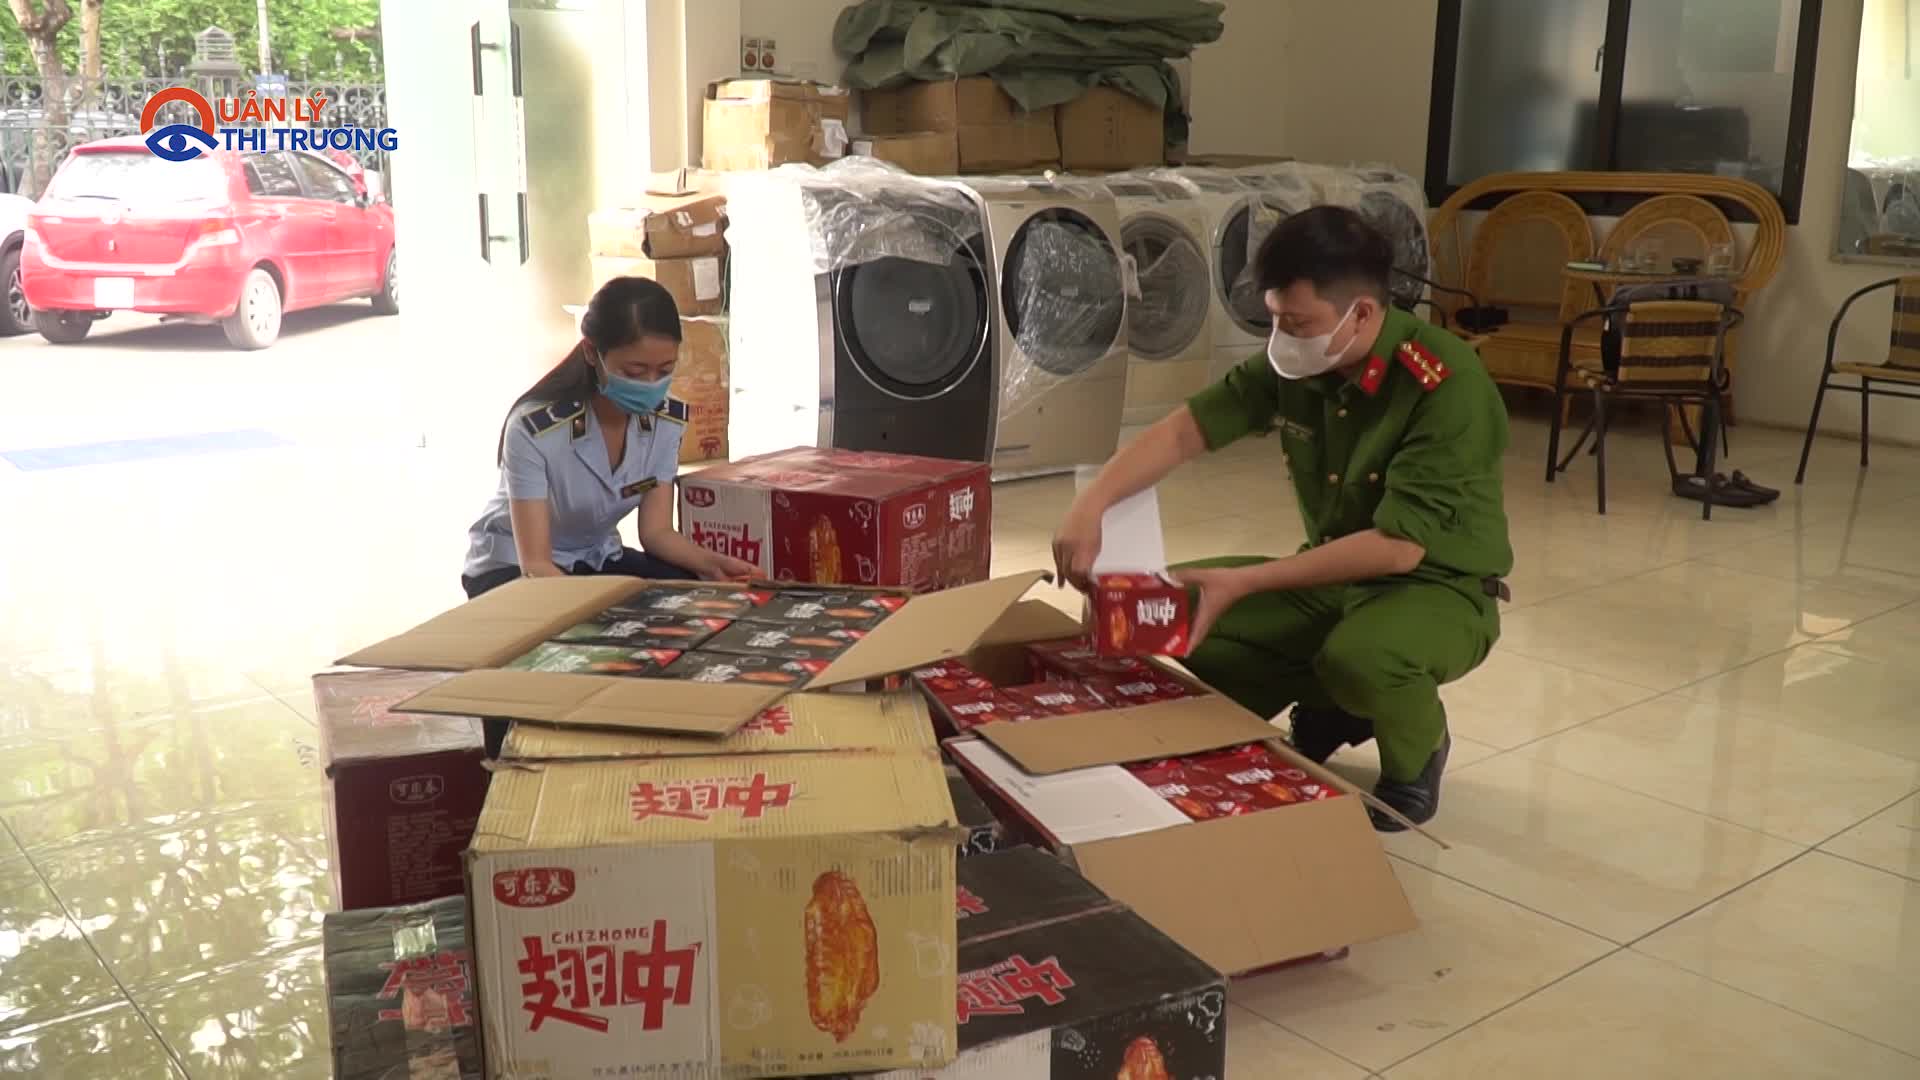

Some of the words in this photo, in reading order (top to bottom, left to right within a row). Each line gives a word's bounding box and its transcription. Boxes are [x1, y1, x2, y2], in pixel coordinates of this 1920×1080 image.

[629, 771, 797, 821] 翅中
[551, 927, 650, 945] CHIZHONG
[517, 919, 702, 1034] 翅中
